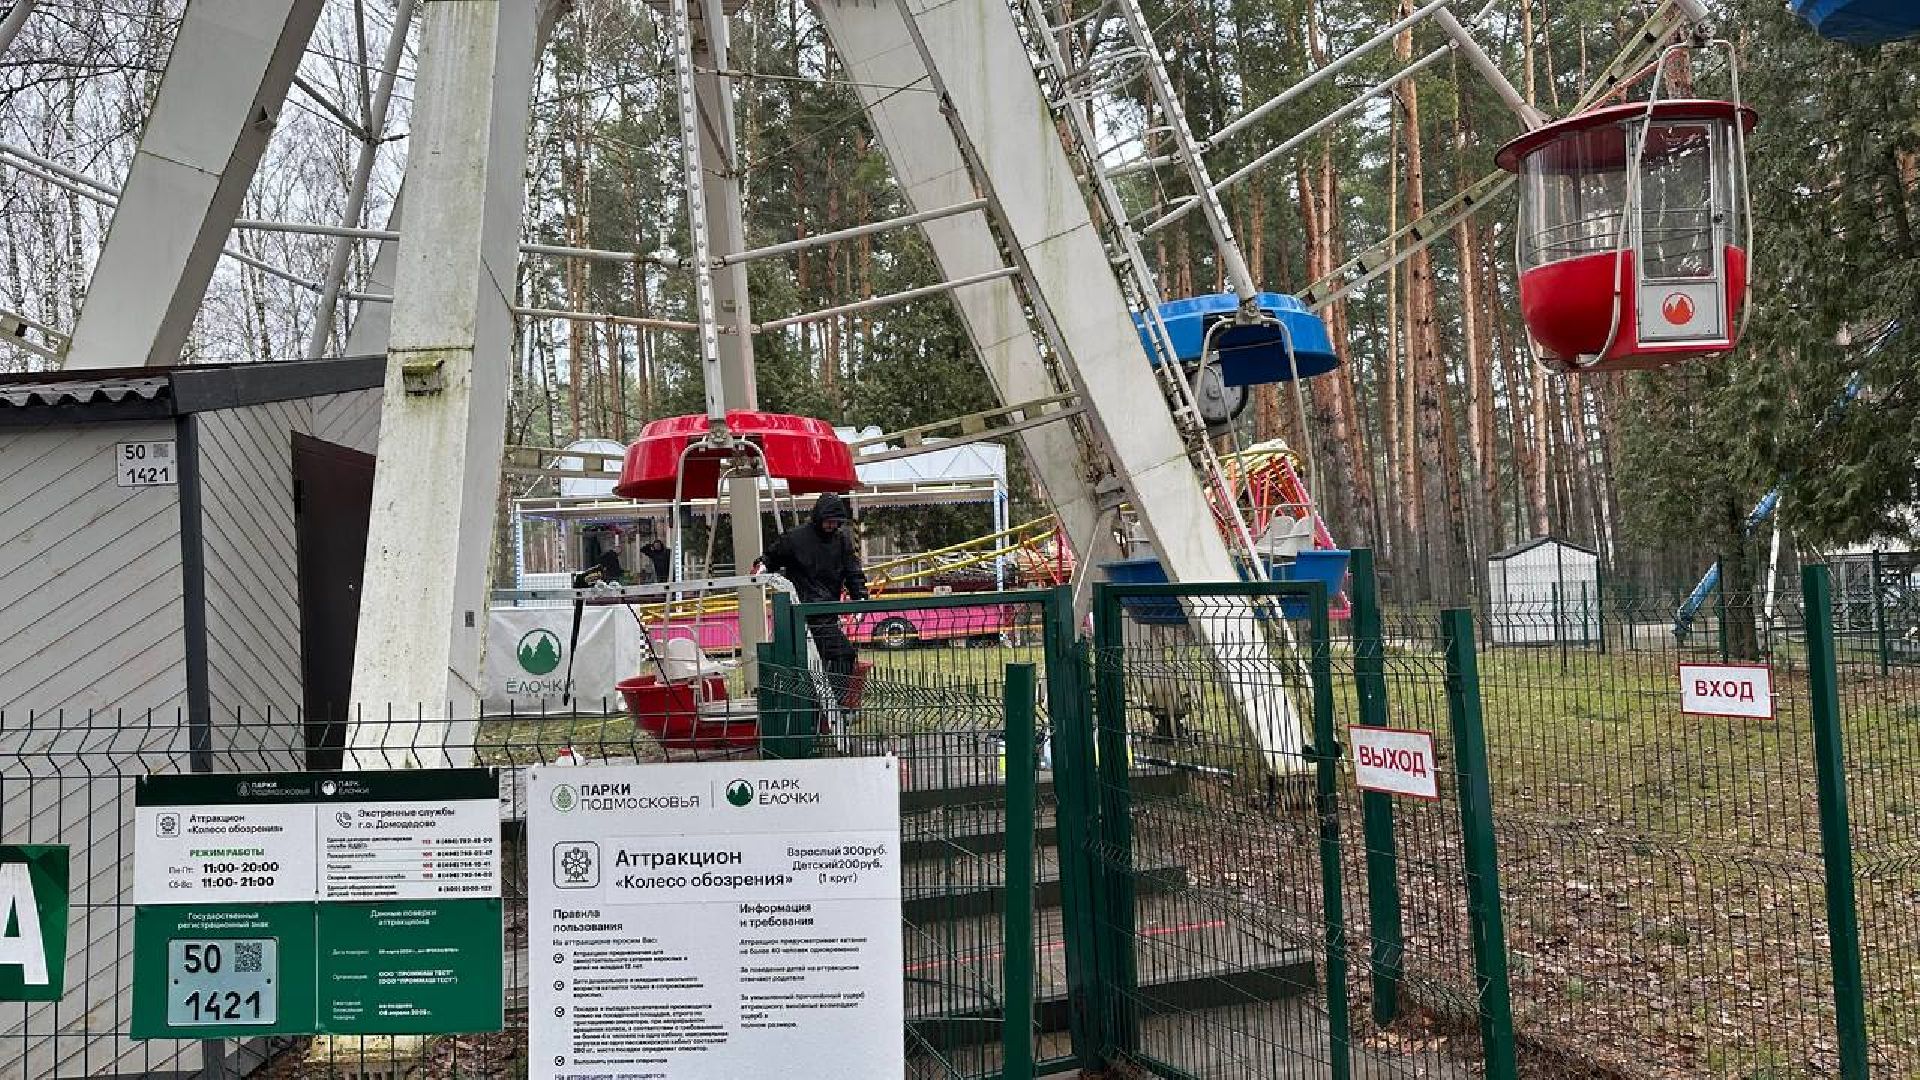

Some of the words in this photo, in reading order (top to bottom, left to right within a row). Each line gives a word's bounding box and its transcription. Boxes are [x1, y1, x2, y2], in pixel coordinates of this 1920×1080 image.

[125, 445, 145, 459] 50
[127, 467, 168, 483] 1421
[1695, 680, 1754, 702] ВХОД
[1359, 745, 1426, 778] ВЫХОД
[581, 784, 631, 796] ПАРКИ
[758, 779, 800, 791] ПАРК
[758, 790, 820, 805] ЁЛОЧКИ
[581, 796, 700, 811] ПОДМОСКОВЬЯ
[358, 809, 415, 817] Экстренные
[418, 807, 455, 817] службы
[190, 814, 244, 823] Аттракцион
[188, 825, 226, 834] «Колесо
[228, 824, 283, 834] обозрения»
[376, 820, 436, 829] Домодедово
[190, 849, 226, 857] РЕЖИМ
[616, 849, 742, 870] Аттракцион
[242, 862, 279, 872] 20:00
[240, 877, 274, 887] 21:00
[616, 875, 686, 889] «Колесо
[691, 873, 793, 888] обозрения»
[829, 873, 858, 884] круг)
[552, 909, 600, 919] Правила
[739, 904, 811, 914] Информация
[188, 912, 259, 921] Государственный
[177, 921, 249, 930] регистрационный
[552, 923, 623, 932] пользования
[750, 917, 814, 928] требования
[184, 944, 221, 973] 50
[184, 990, 260, 1020] 1421
